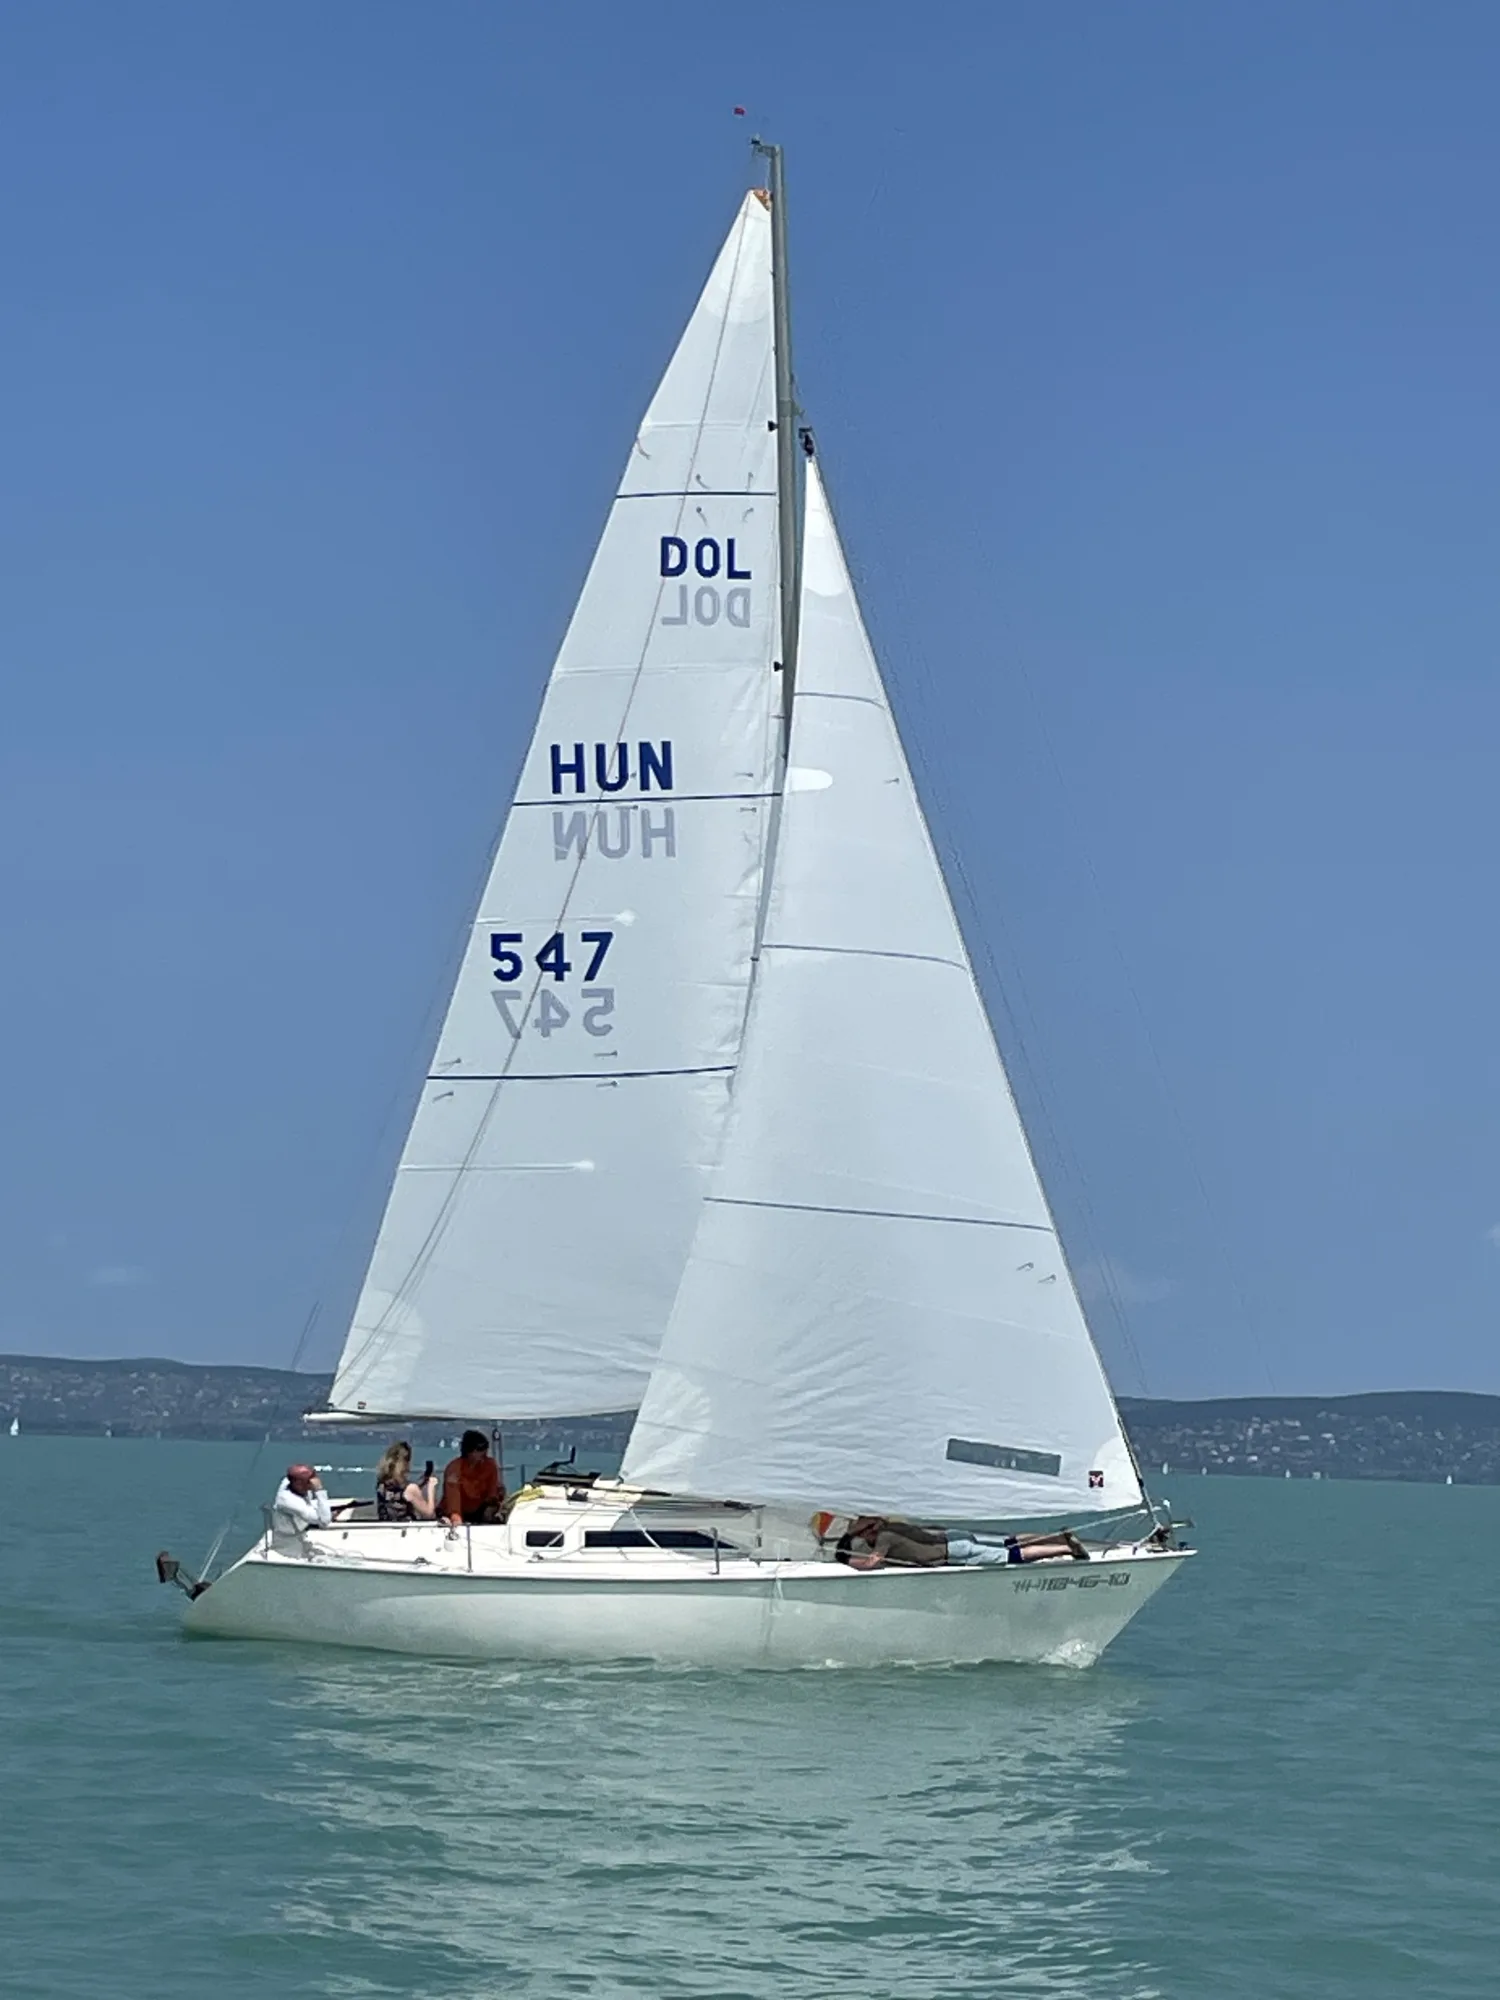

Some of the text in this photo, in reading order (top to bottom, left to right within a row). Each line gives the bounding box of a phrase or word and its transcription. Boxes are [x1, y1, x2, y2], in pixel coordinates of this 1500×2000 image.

[660, 536, 752, 580] DOL
[550, 741, 673, 794] HUN
[490, 931, 614, 982] 547
